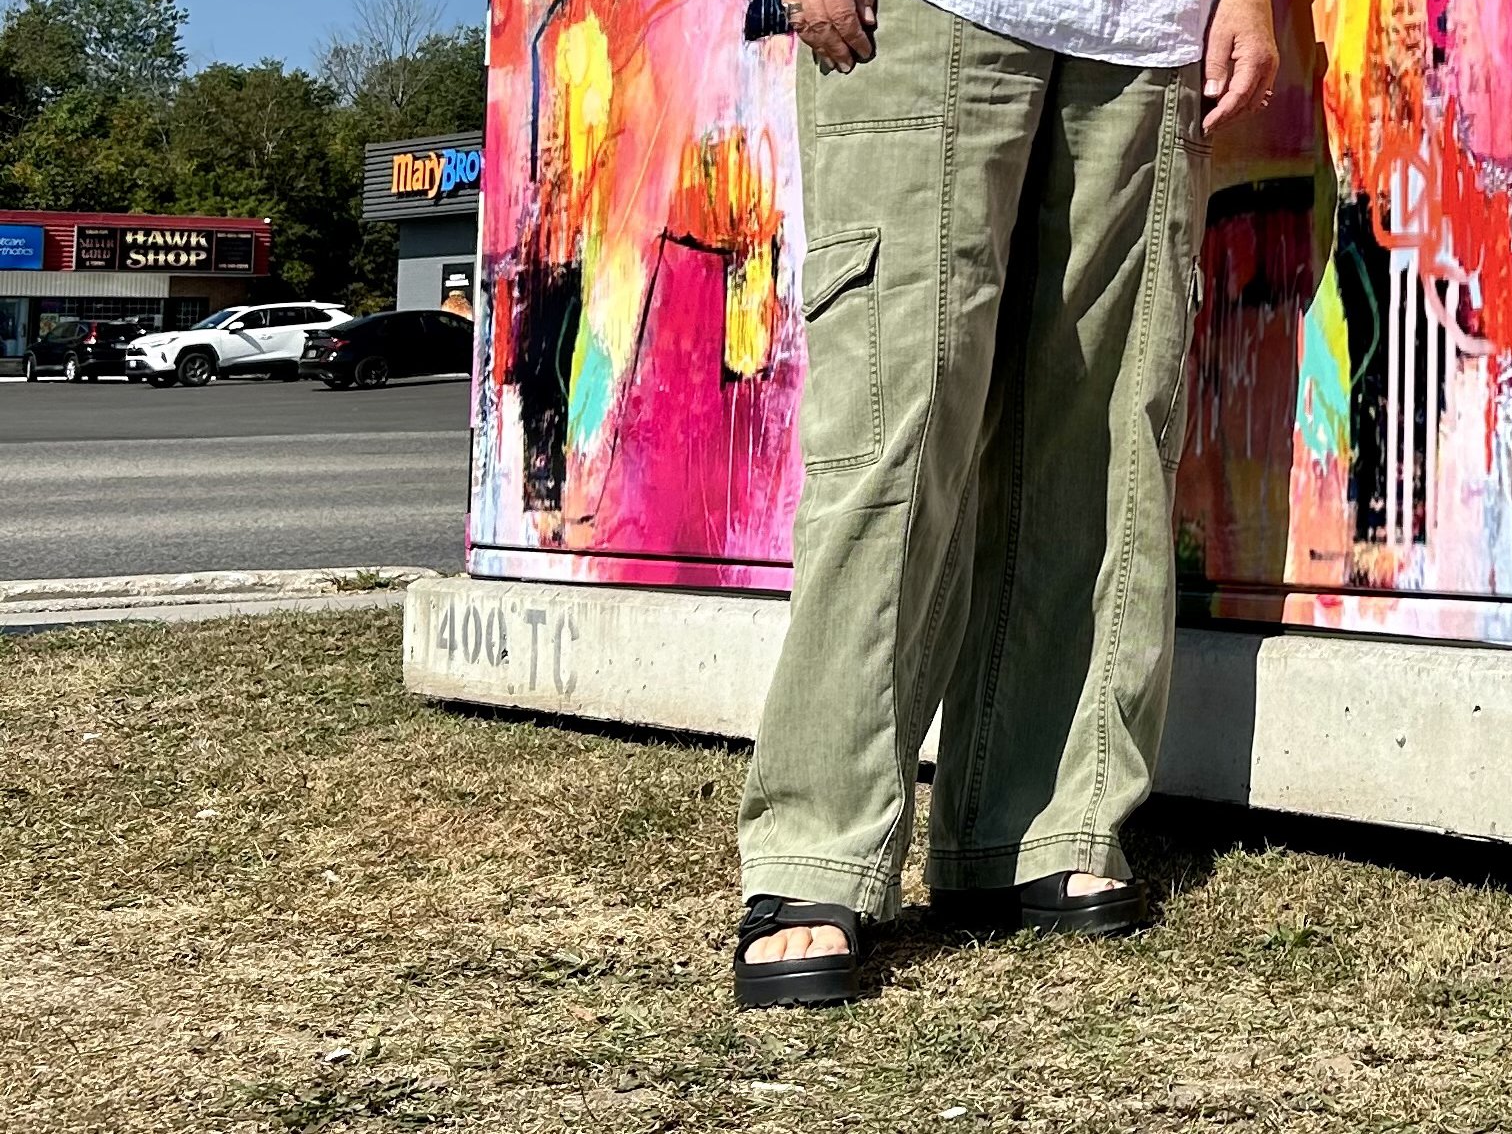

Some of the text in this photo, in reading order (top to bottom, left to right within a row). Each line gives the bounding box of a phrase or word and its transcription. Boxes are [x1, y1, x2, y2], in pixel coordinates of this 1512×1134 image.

[126, 248, 207, 269] SHOP
[436, 601, 580, 702] 400 TC
